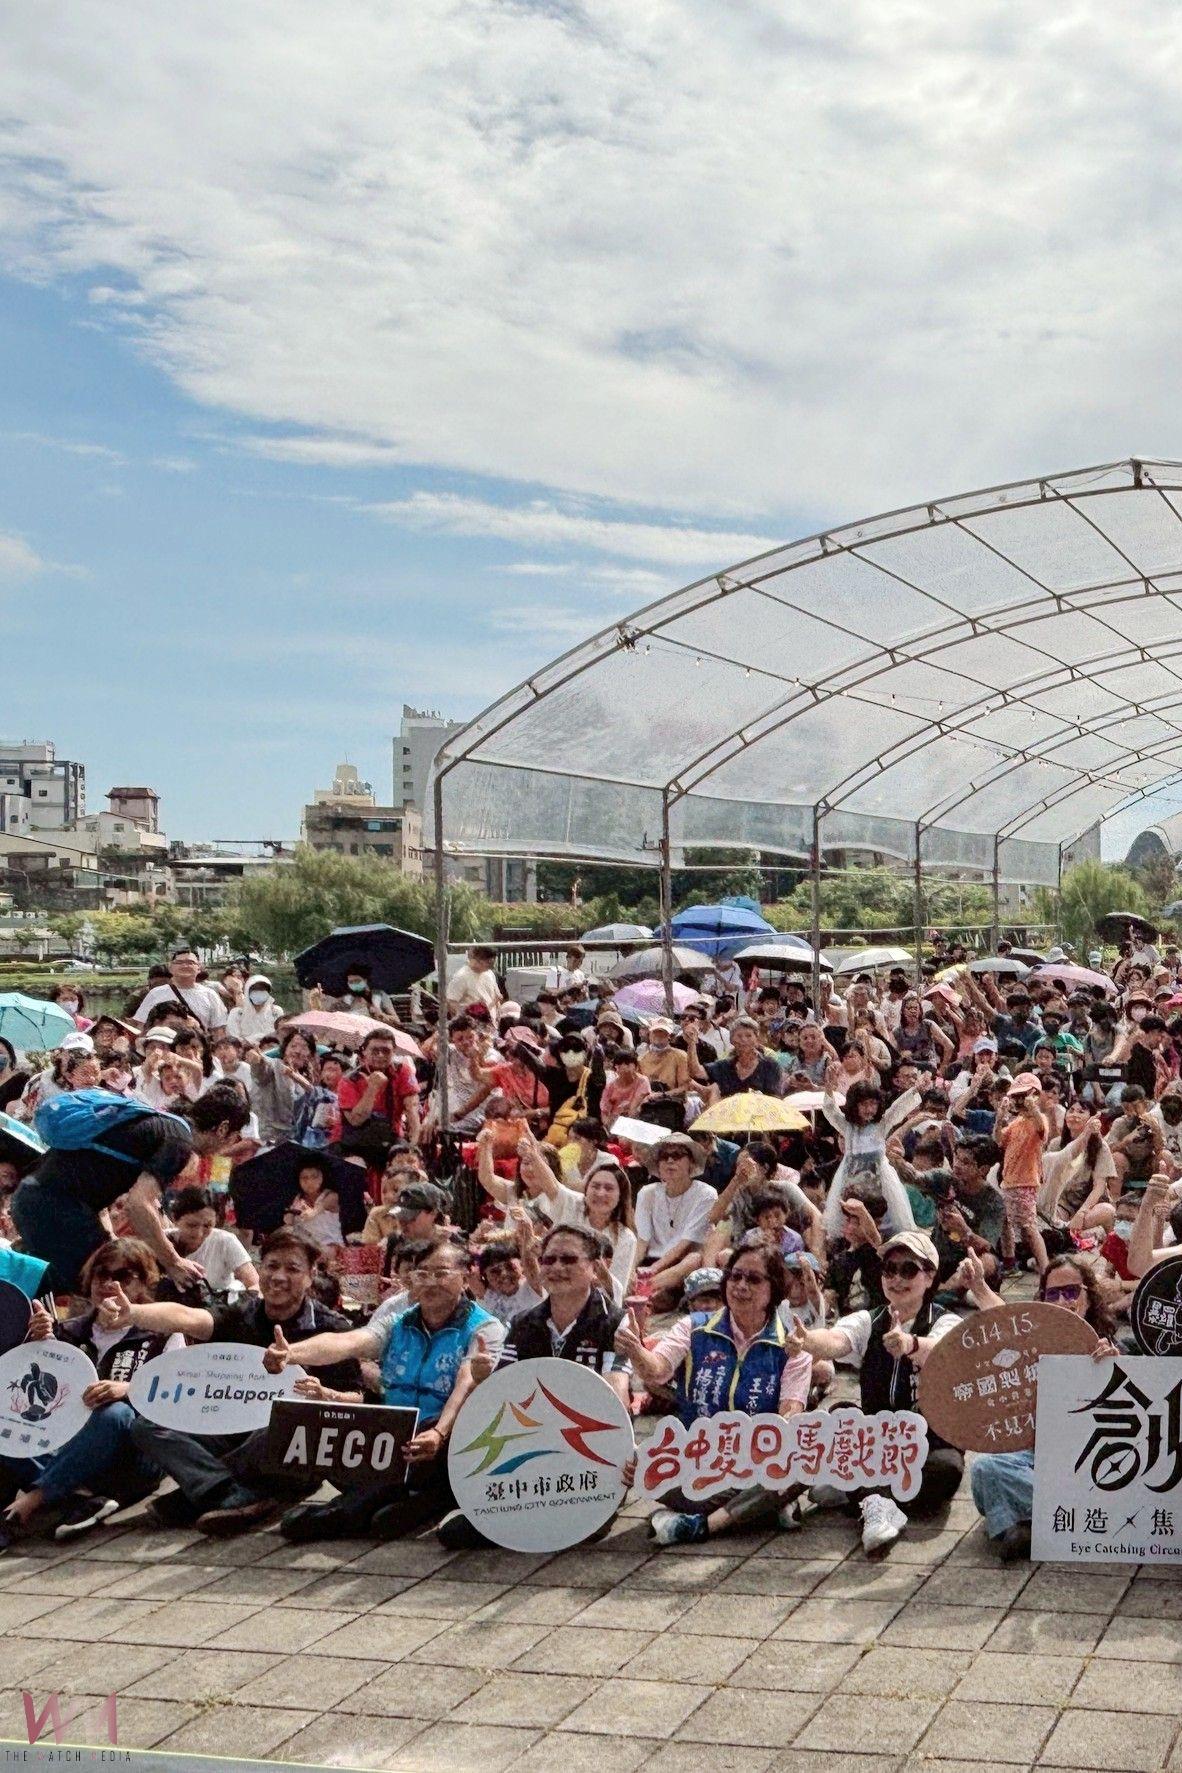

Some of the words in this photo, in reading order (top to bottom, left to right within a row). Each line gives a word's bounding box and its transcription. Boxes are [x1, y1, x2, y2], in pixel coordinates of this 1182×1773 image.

[1010, 1312, 1033, 1336] 15
[283, 1425, 396, 1471] AECO
[485, 1470, 599, 1501] 臺中市政府
[1052, 1505, 1109, 1534] 創造
[1071, 1542, 1091, 1555] Eye
[1095, 1542, 1146, 1556] Catching
